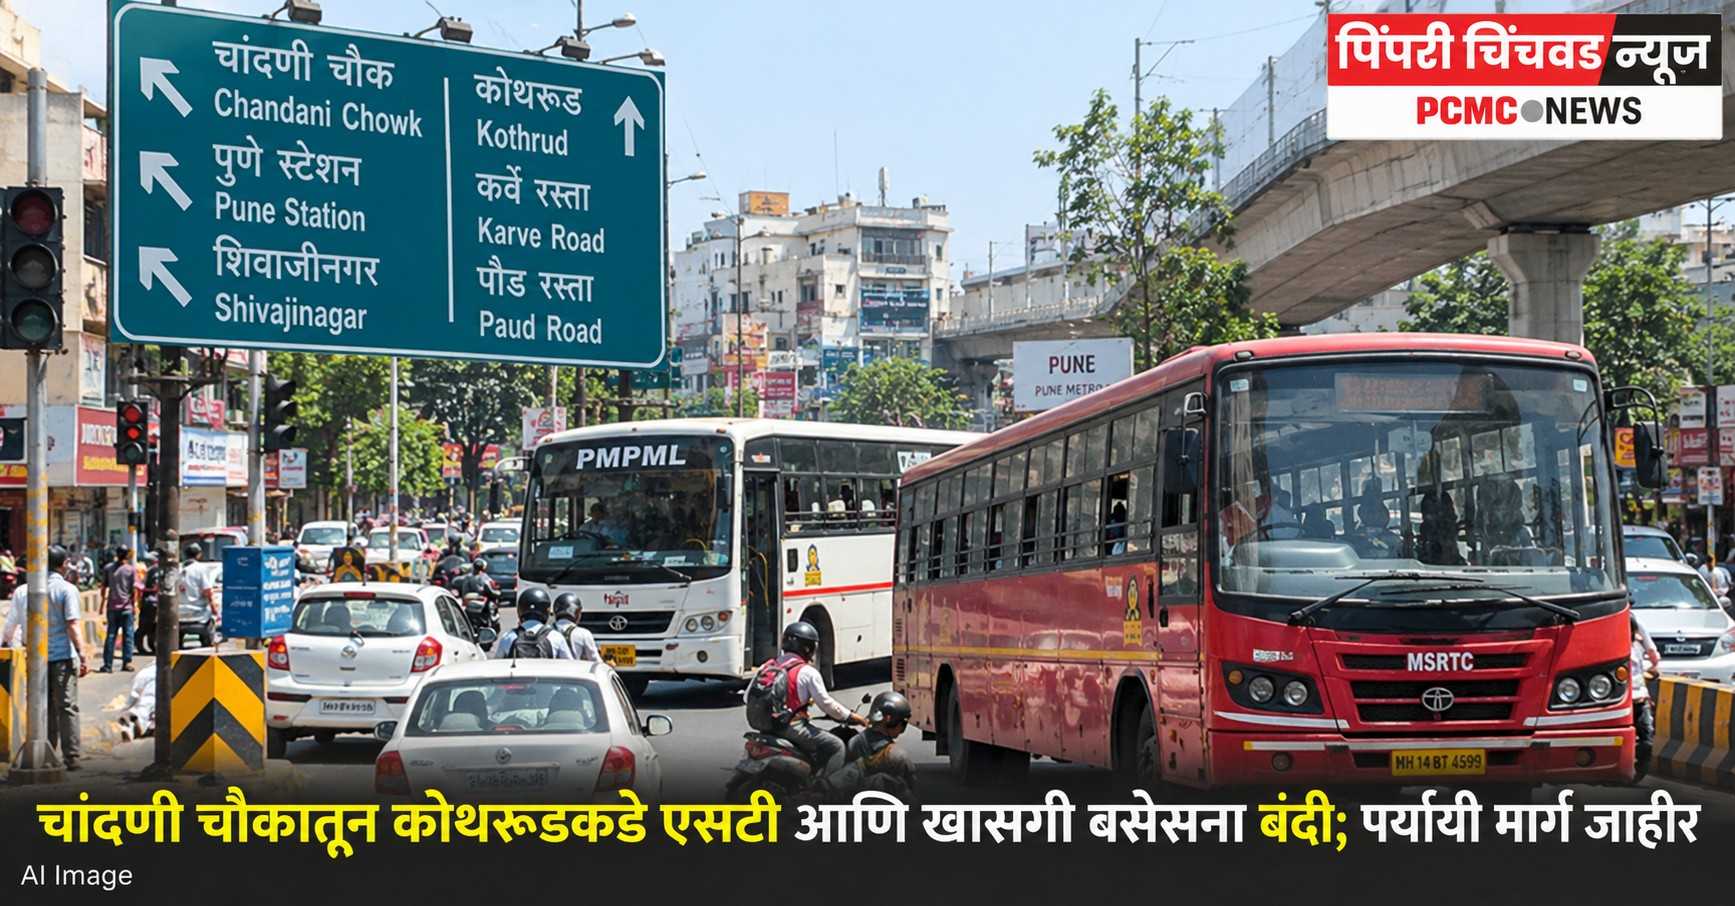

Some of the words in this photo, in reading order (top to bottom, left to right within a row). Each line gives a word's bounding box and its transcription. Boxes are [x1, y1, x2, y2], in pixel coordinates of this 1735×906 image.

[213, 35, 313, 80] चांदणी
[327, 44, 394, 89] चौक
[474, 67, 582, 115] कोथरूड
[215, 88, 330, 126] Chandani
[343, 103, 421, 136] Chowk
[478, 119, 567, 155] Kothrud
[213, 136, 263, 186] पुणे
[277, 140, 361, 185] स्टेशन
[476, 165, 522, 204] कर्वे
[534, 180, 590, 210] रस्ता
[216, 192, 275, 223] Pune
[285, 198, 364, 231] Station
[479, 217, 541, 247] Karve
[552, 224, 603, 253] Road
[213, 235, 379, 286] शिवाजीनगर
[477, 256, 526, 296] पौड
[539, 273, 593, 301] रस्ता
[216, 293, 367, 335] Shivajinagar
[481, 311, 534, 339] Paud
[548, 316, 601, 343] Road
[1049, 355, 1096, 374] PUNE
[1034, 384, 1063, 397] PUNE
[576, 444, 686, 470] PMPML
[1407, 652, 1474, 672] MSRTC
[1395, 755, 1414, 770] MH
[1418, 755, 1431, 769] 14
[1433, 754, 1449, 769] BT
[1451, 754, 1482, 769] 4599
